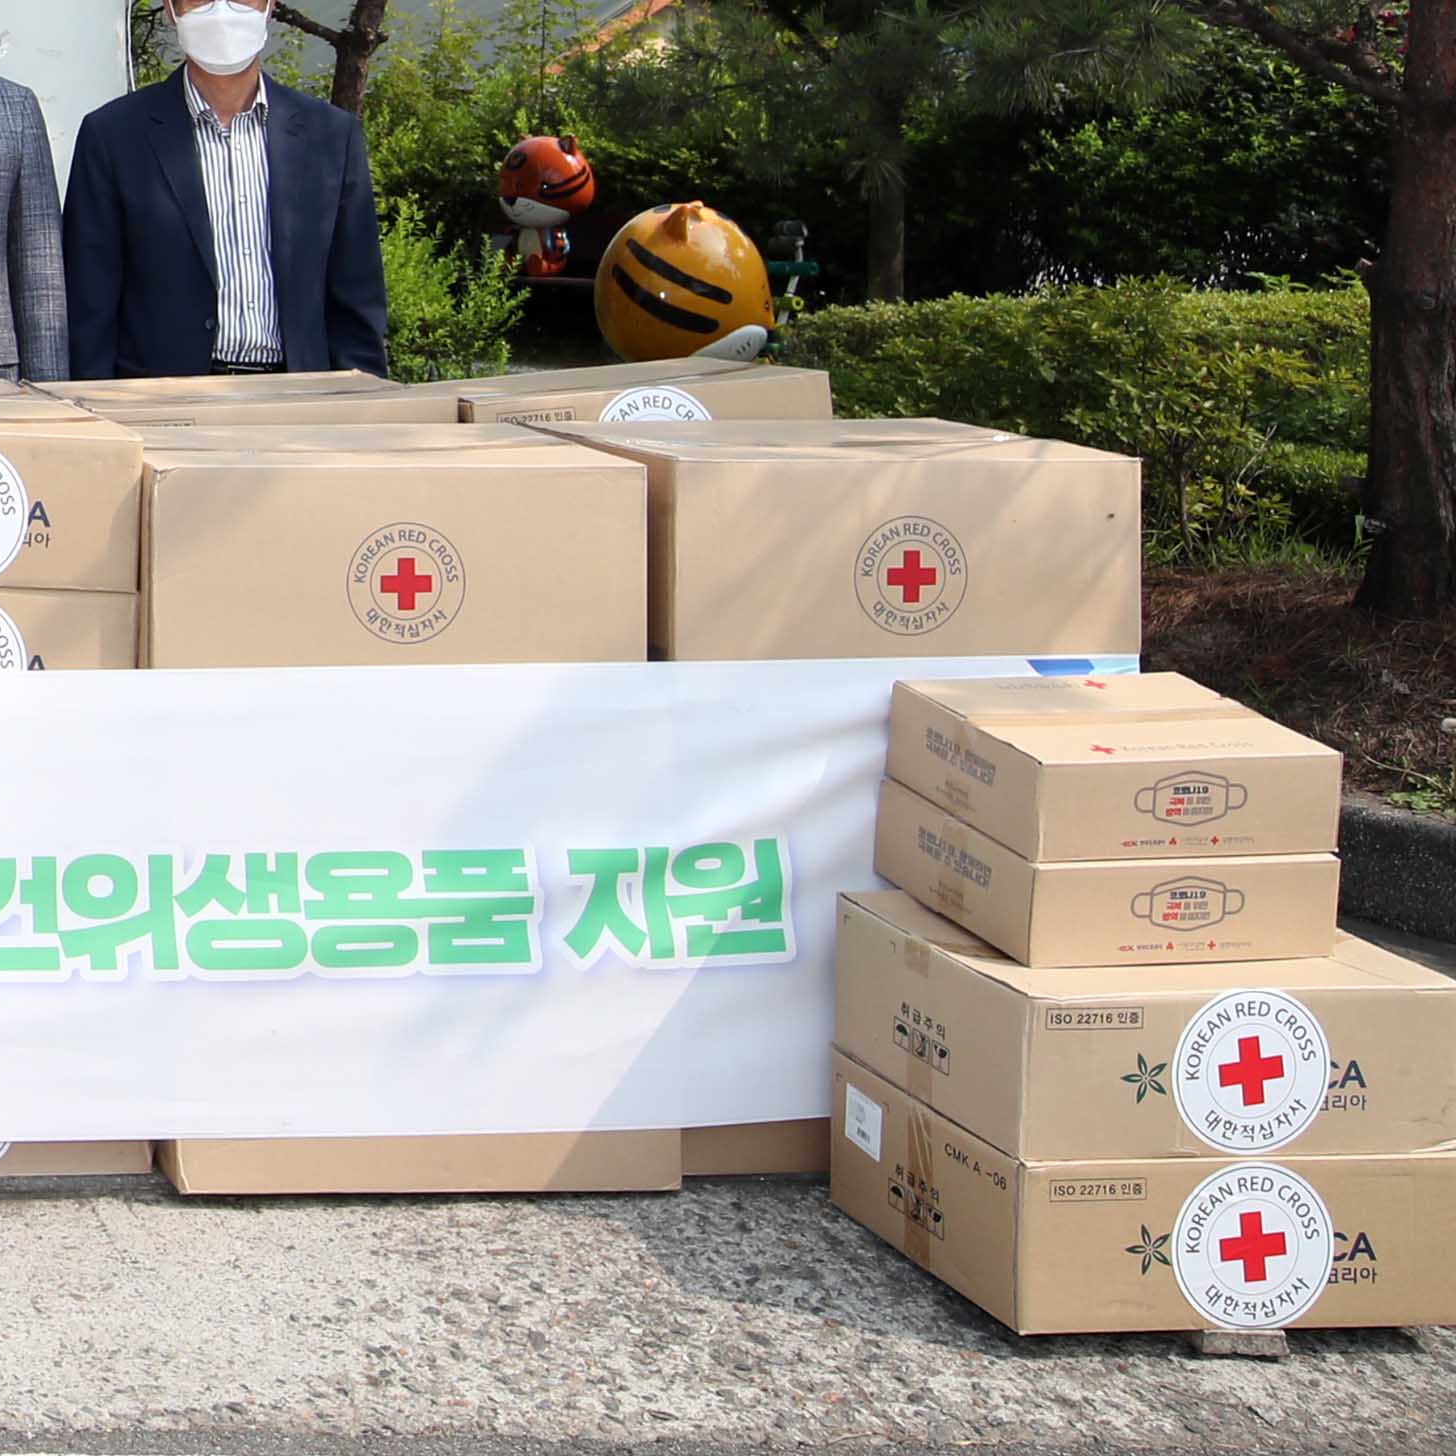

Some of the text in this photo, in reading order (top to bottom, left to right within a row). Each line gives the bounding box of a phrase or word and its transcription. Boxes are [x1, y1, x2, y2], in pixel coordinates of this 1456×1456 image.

[642, 395, 673, 410] RED
[353, 529, 459, 584] KOREAN RED CROSS
[861, 523, 962, 577] KOREAN RED CROSS
[365, 607, 448, 639] 대한적십자사
[872, 600, 950, 631] 대한적십자사
[561, 836, 786, 960] 지원
[900, 1000, 946, 1041] 취급주의
[1050, 1011, 1140, 1025] ISO 22716 인증
[1184, 1000, 1317, 1081] KOREAN RED CROSS
[1203, 1097, 1307, 1143] 대한적십자사
[943, 1142, 1008, 1191] CMK A -06
[1053, 1183, 1143, 1196] ISO 22716 인증
[1185, 1175, 1321, 1254] KOREAN RED CROSS
[1204, 1277, 1311, 1320] 대한적십자사
